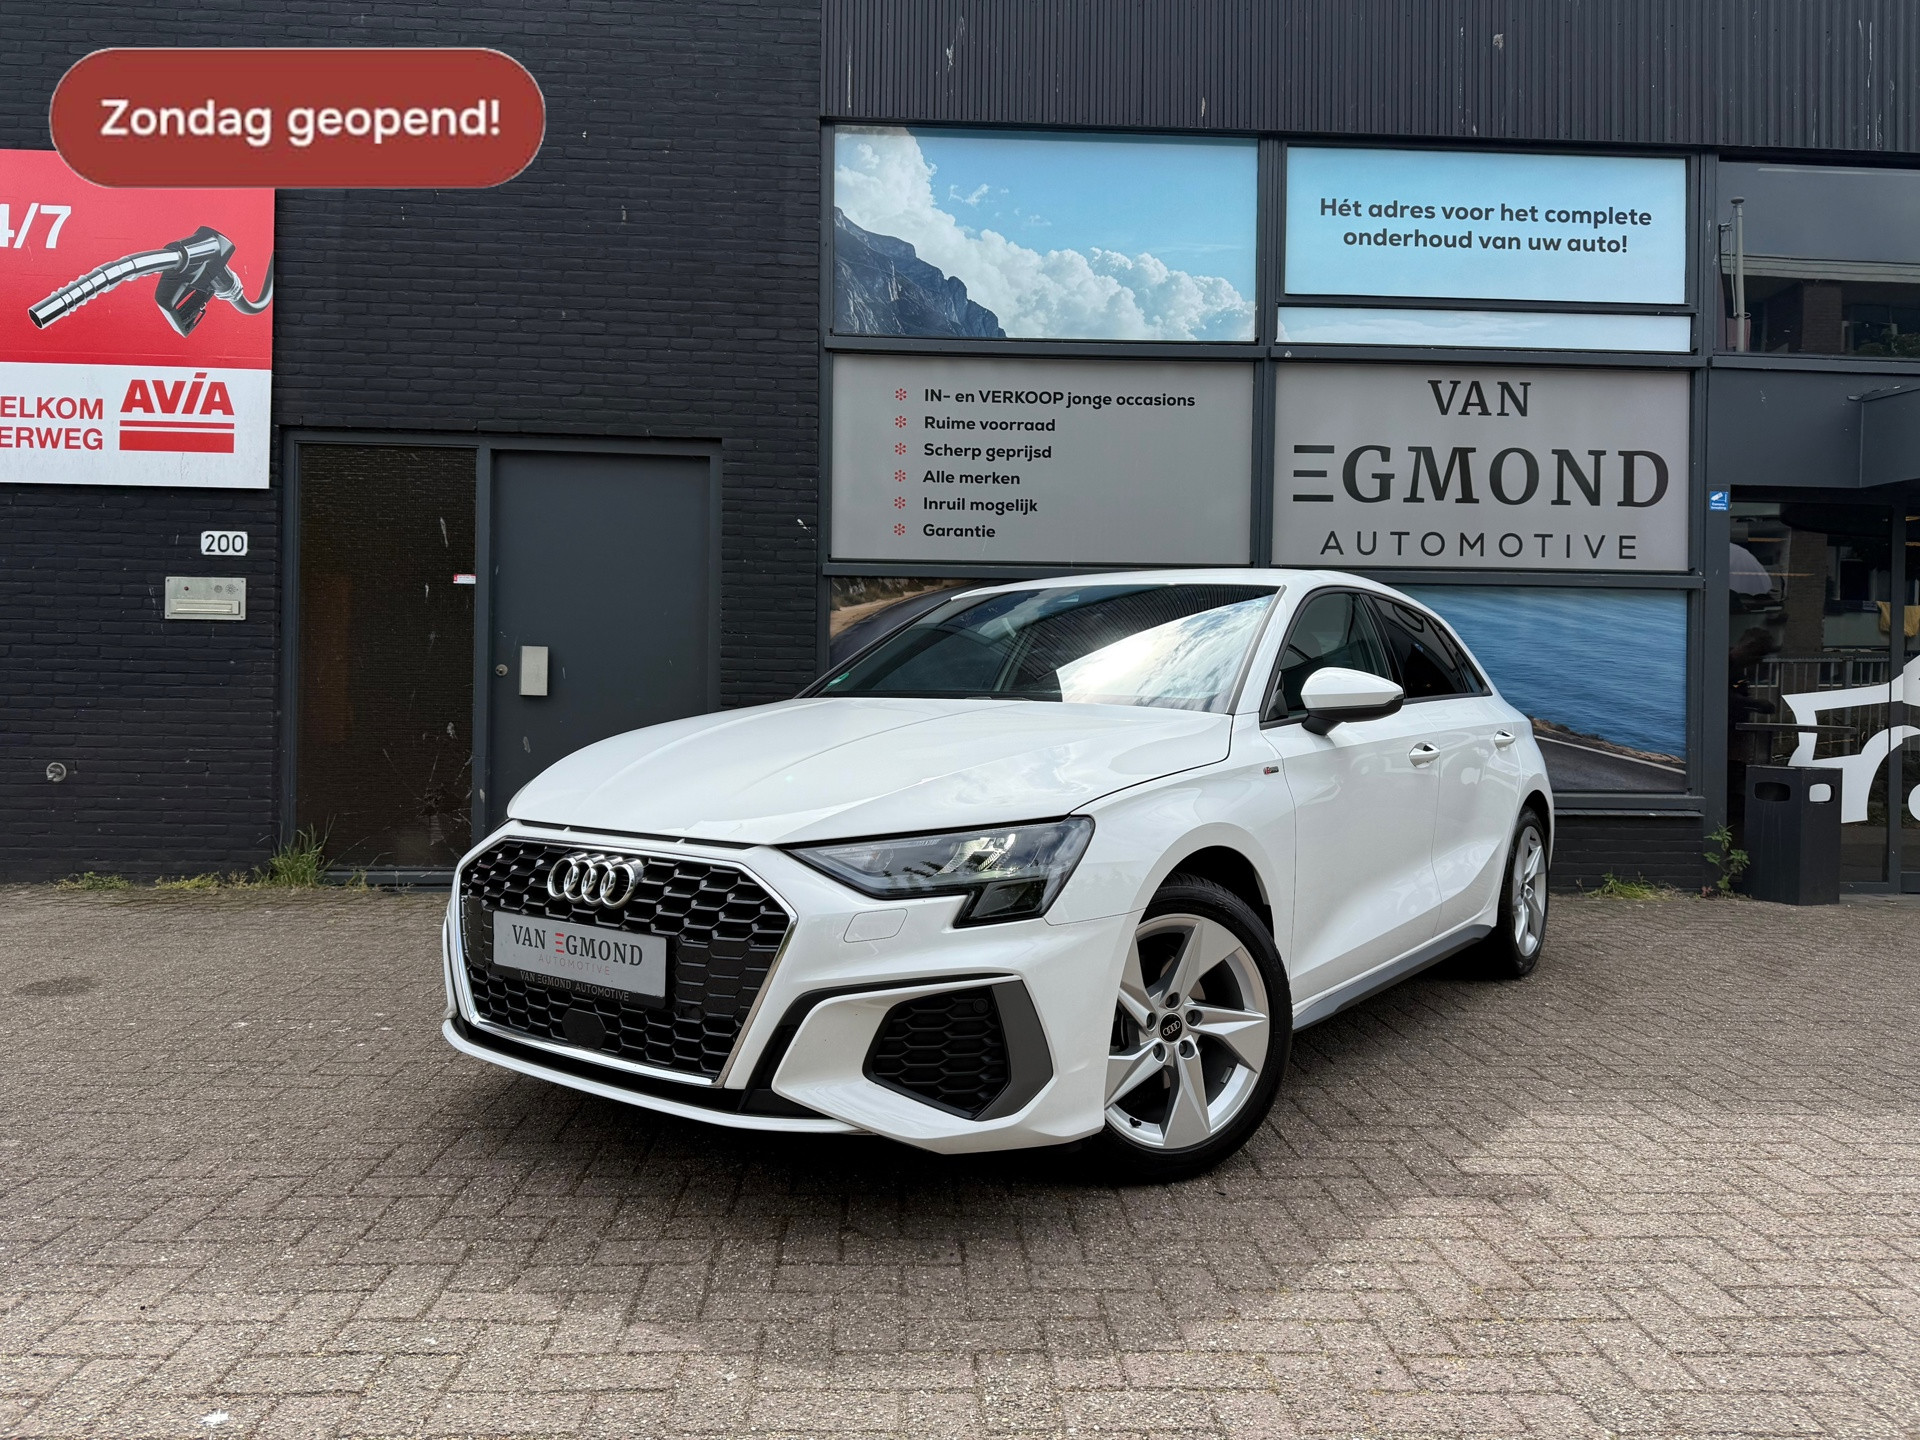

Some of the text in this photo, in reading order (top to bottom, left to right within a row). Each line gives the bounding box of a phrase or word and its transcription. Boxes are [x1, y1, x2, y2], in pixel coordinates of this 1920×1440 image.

[1320, 197, 1652, 229] Hét adres voor het complete
[1343, 228, 1628, 254] onderhoud van uw auto!
[924, 388, 1196, 410] IN- en VERKOOP jonge occasions
[1427, 379, 1532, 418] VAN
[924, 415, 1056, 432] Ruime voorraad
[923, 442, 1052, 461] Scherp geprijsd
[923, 470, 1021, 486] Alle merken
[1292, 444, 1670, 508] EGMOND
[923, 496, 1038, 516] Inruil mogelijk
[923, 523, 996, 539] Garantie
[204, 534, 244, 553] 200
[1320, 529, 1638, 561] AUTOMOTIVE
[512, 925, 643, 966] VAN EGMOND
[538, 955, 610, 976] AUTOMOTIVE
[520, 971, 629, 1001] VAN EGMOND AUTOMOTIVE
